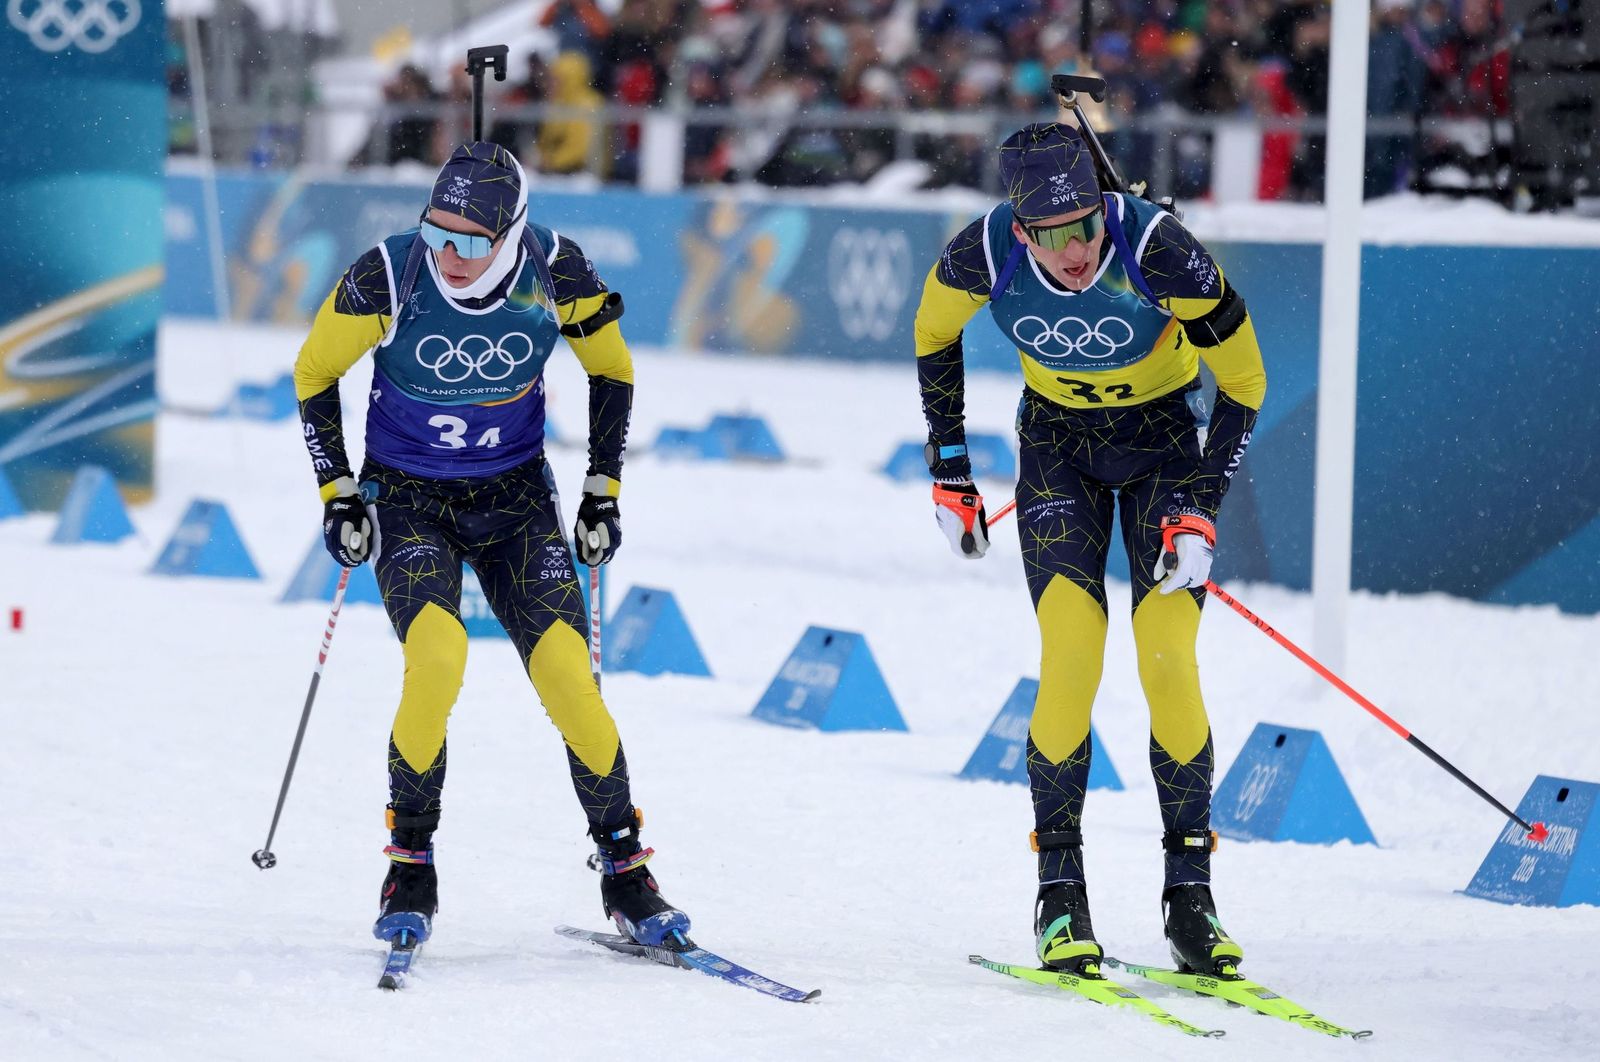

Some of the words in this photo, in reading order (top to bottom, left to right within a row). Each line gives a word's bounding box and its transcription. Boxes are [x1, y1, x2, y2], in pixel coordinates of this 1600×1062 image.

[442, 193, 469, 209] SWE
[1051, 191, 1079, 206] SWE
[1201, 264, 1218, 294] SWE
[408, 383, 458, 396] MILANO
[460, 387, 512, 395] CORTINA
[427, 414, 468, 450] 3
[302, 422, 334, 472] SWE
[1024, 499, 1076, 515] SWEDEMOUNT
[539, 569, 572, 580] SWE
[1057, 974, 1080, 988] FISCHER
[1195, 977, 1218, 990] FISCHER
